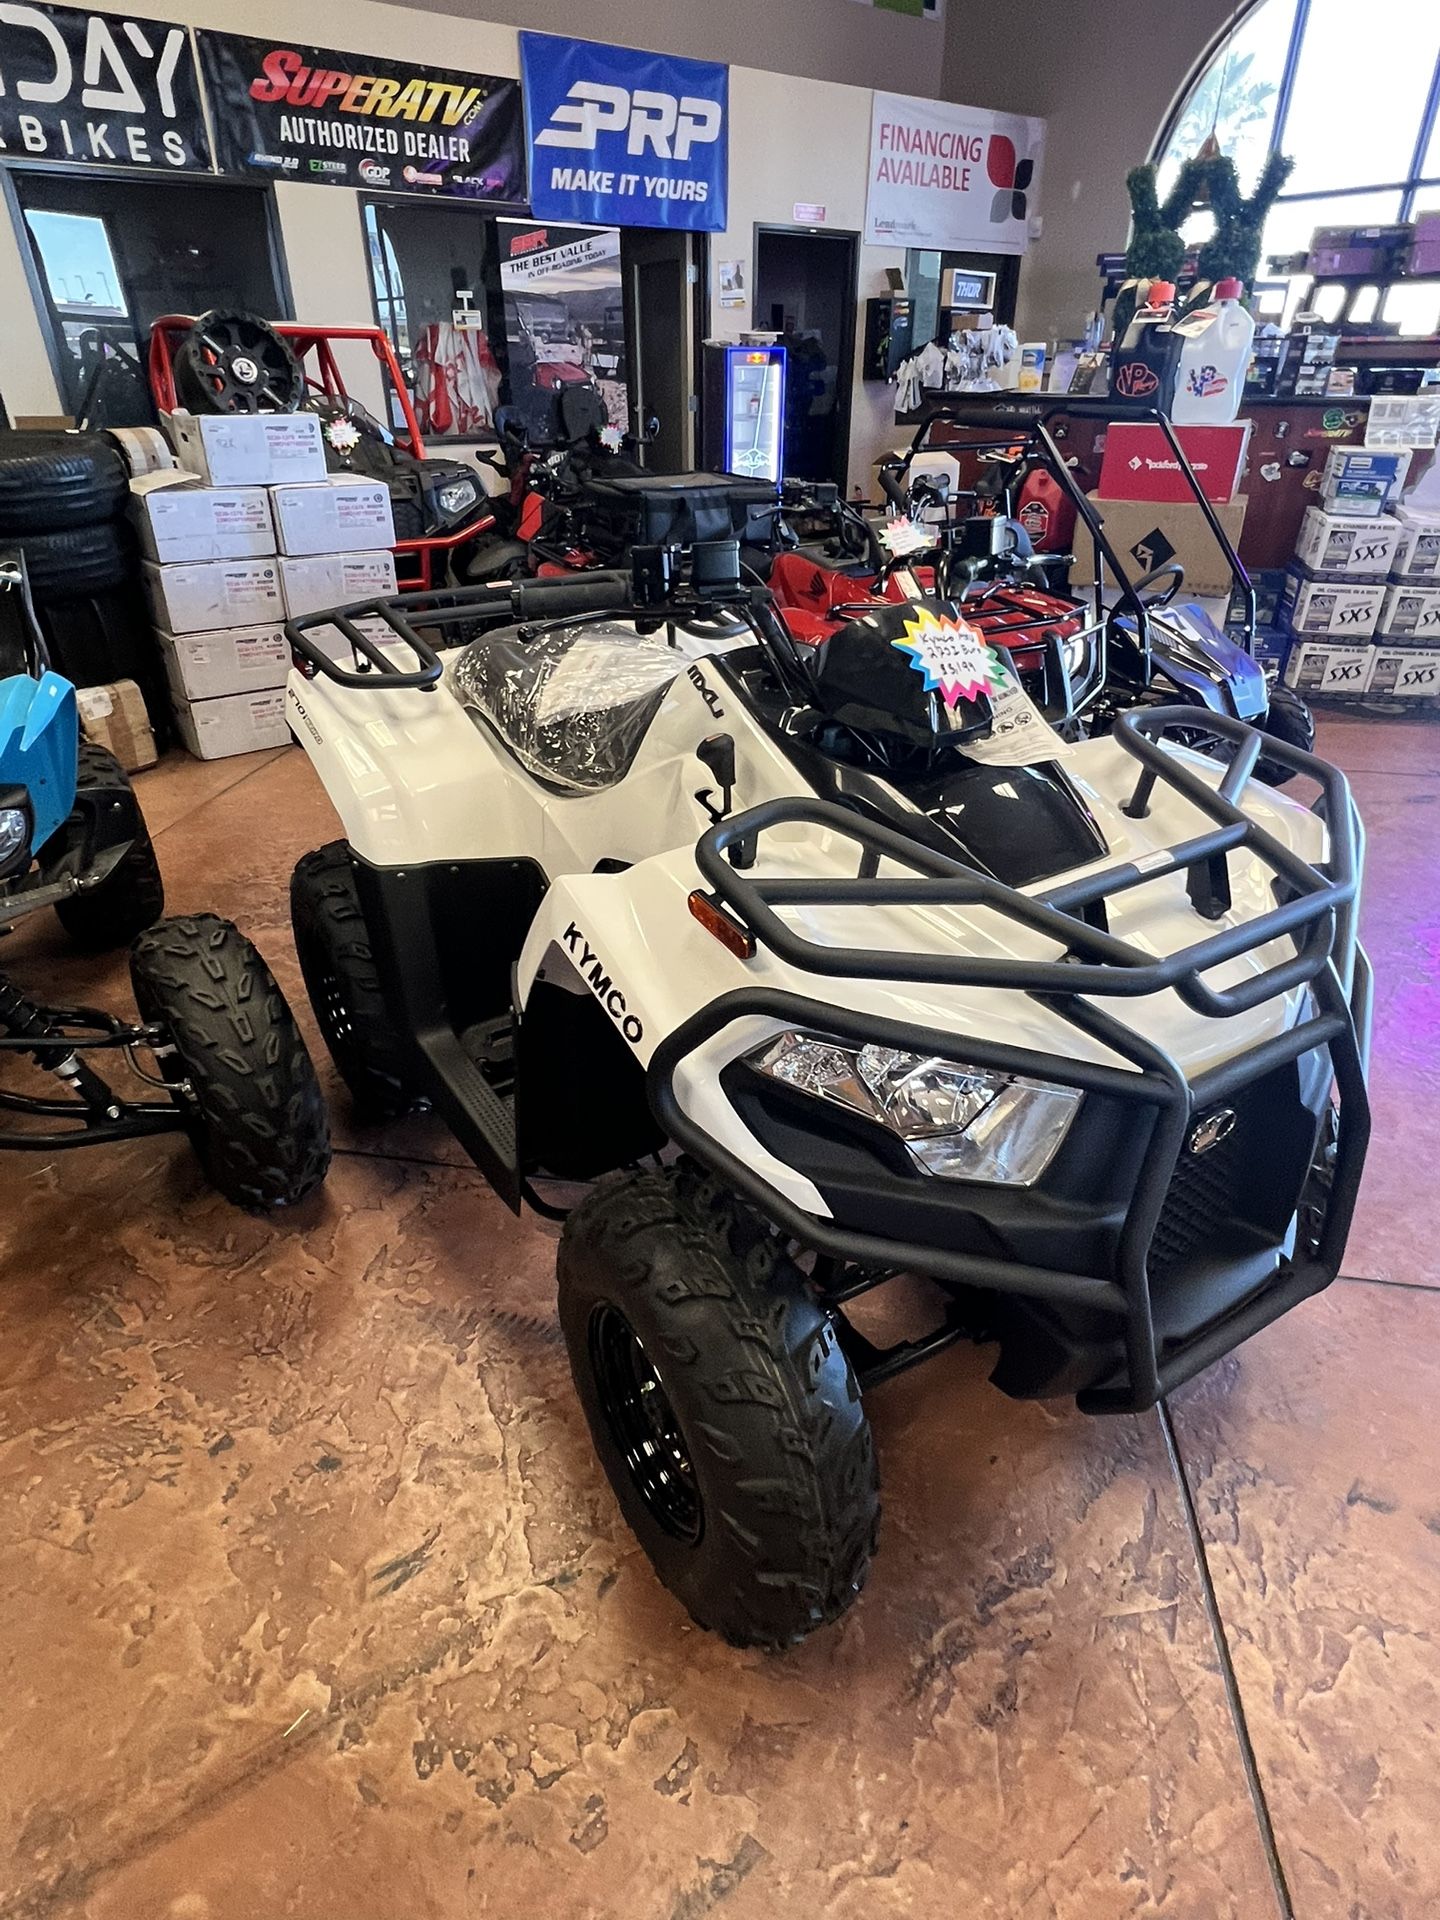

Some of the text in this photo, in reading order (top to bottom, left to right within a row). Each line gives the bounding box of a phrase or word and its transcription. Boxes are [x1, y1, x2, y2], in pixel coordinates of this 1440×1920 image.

[0, 3, 185, 118] DAY
[249, 50, 482, 126] SUPERATV
[18, 115, 187, 166] BIKES
[280, 115, 471, 163] AUTHORIZED DEALER
[534, 80, 722, 161] PRP
[879, 123, 984, 163] FINANCING
[366, 166, 391, 180] GDP
[551, 167, 709, 202] MAKE IT YOURS
[876, 157, 971, 192] AVAILABLE
[510, 241, 593, 274] THE BEST VALUE
[528, 271, 536, 279] IN
[584, 249, 607, 261] TODAY
[956, 281, 982, 298] THOR
[563, 921, 643, 1043] KYMCO
